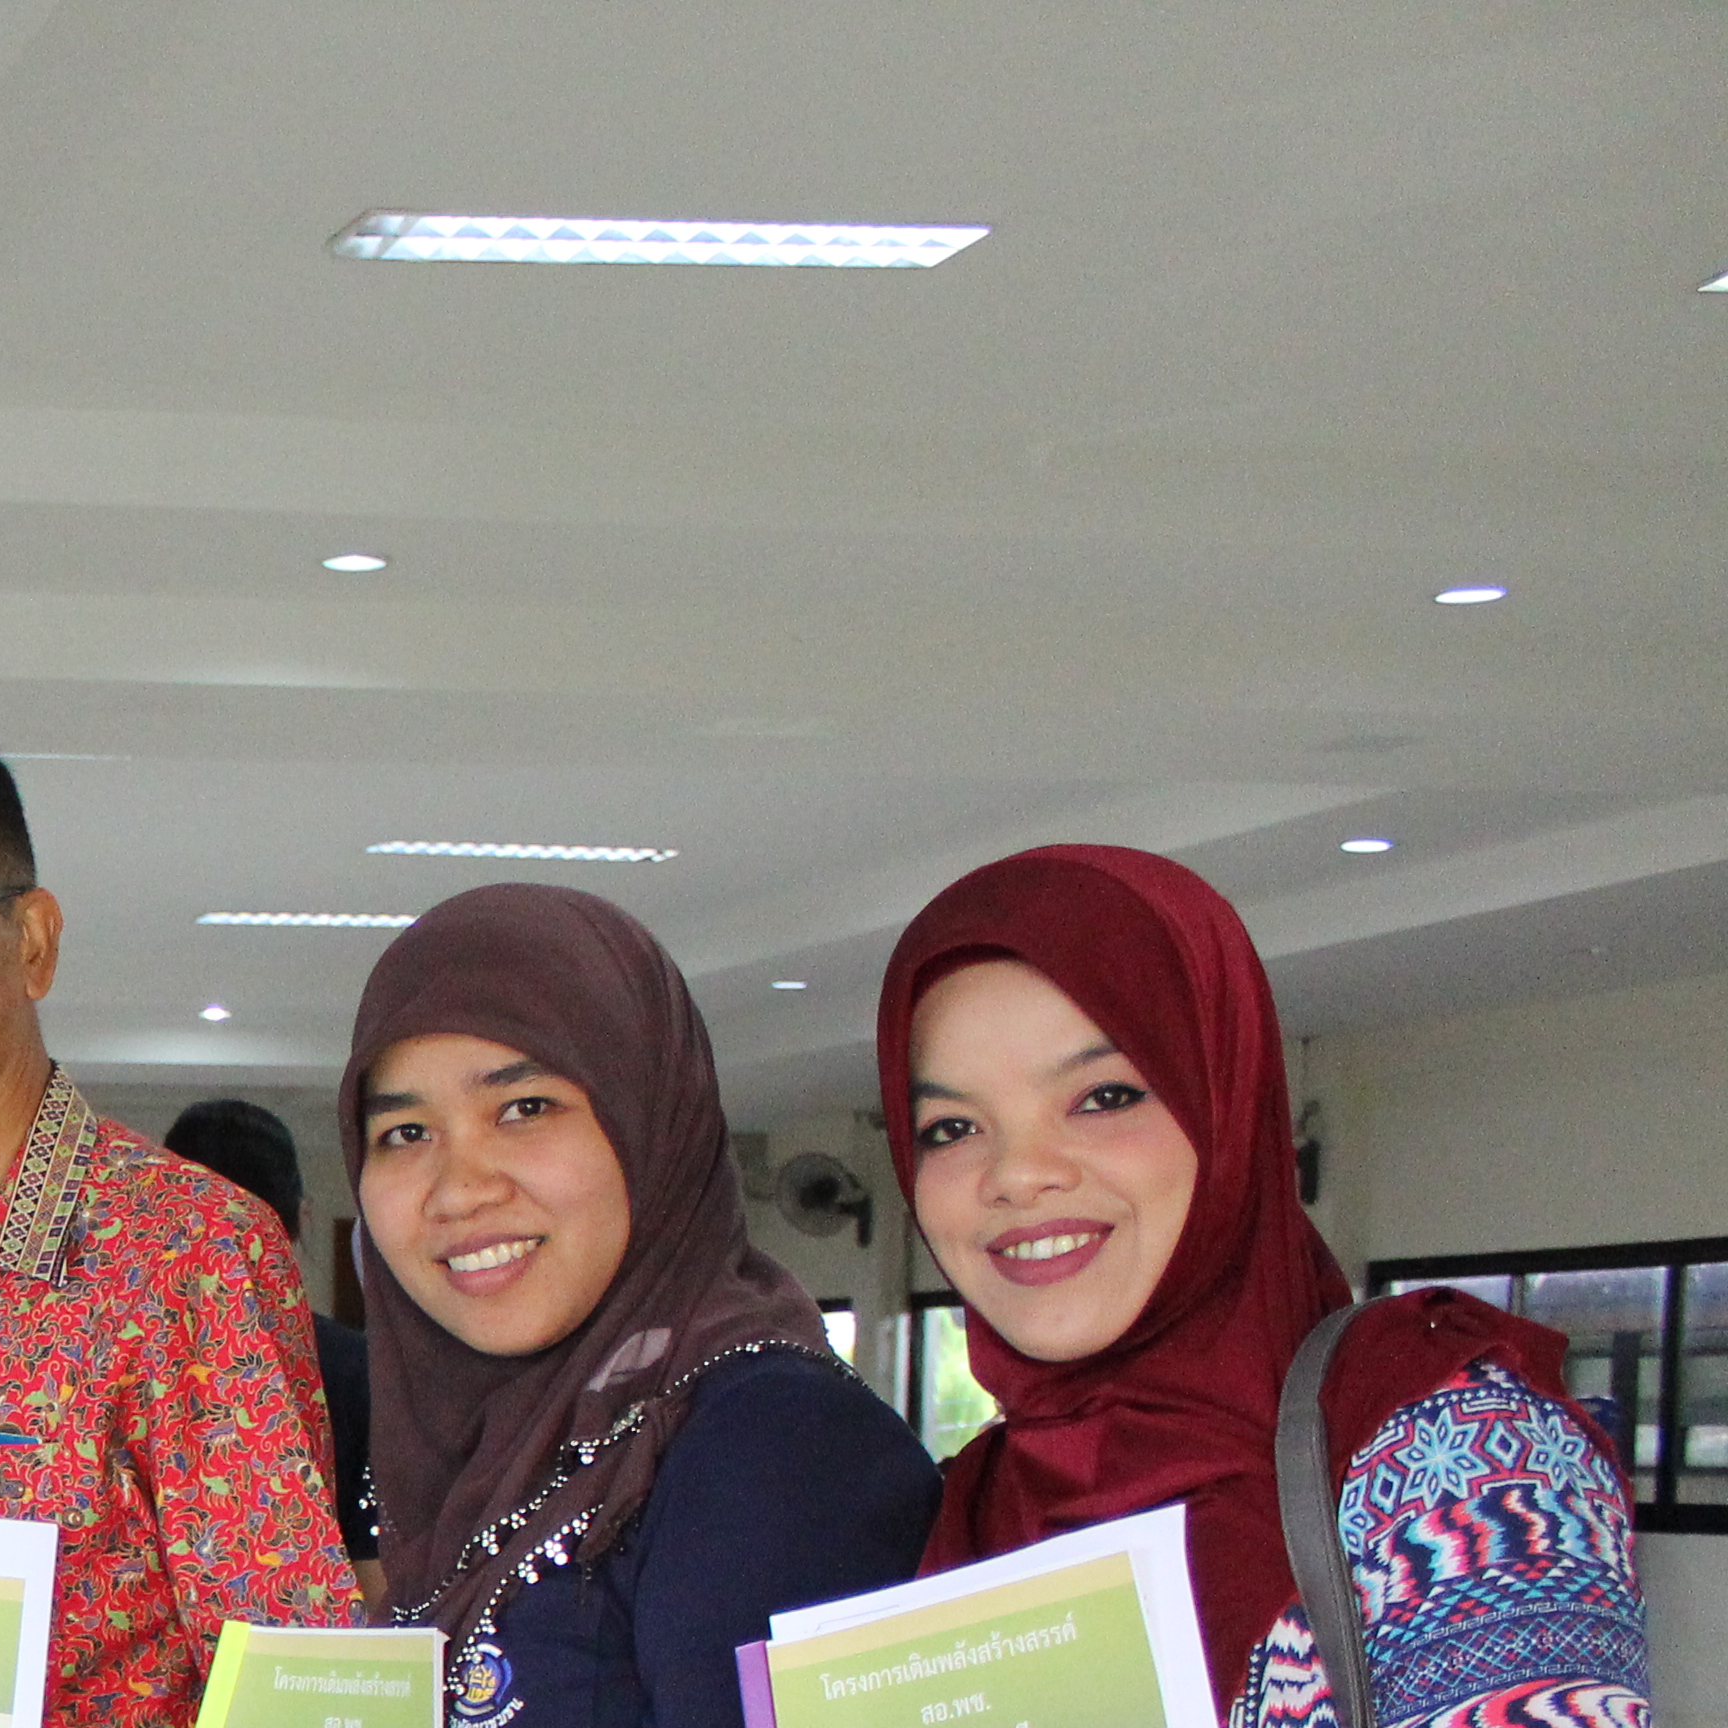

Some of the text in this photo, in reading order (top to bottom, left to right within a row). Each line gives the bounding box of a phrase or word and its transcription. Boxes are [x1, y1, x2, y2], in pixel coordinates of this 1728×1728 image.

[819, 1611, 1079, 1700] โครงการเติมพลังสร้างสรรค์
[273, 1666, 412, 1698] โครงการเติมพลังสร้างสรรค์
[920, 1691, 992, 1726] สอ.พช.
